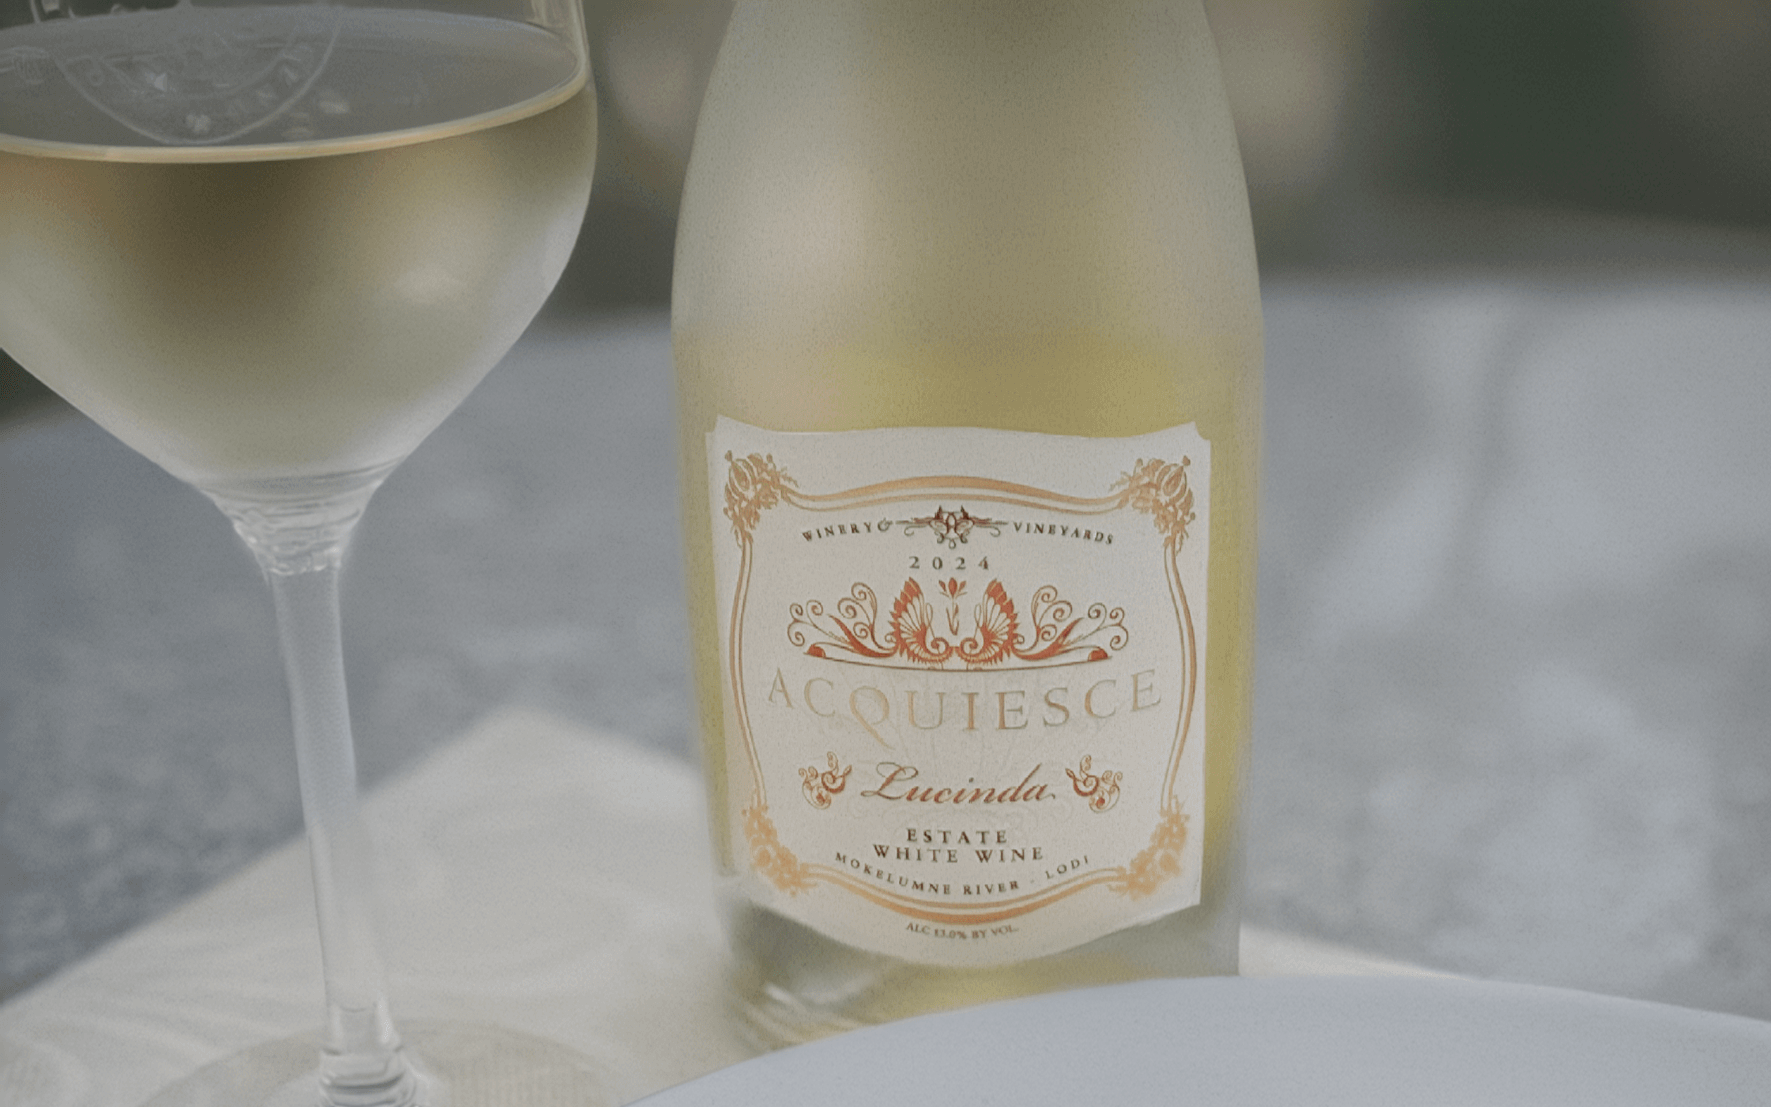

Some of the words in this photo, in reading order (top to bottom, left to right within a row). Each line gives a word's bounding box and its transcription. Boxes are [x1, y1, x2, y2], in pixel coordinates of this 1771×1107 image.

[802, 521, 872, 542] WINERY
[1013, 521, 1113, 545] VINEYARDS
[908, 555, 990, 571] 2024
[767, 667, 1163, 751] ACQUIESCE
[860, 761, 1055, 804] Lucinda
[906, 828, 1008, 844] ESTATE
[873, 844, 959, 864] WHITE
[974, 847, 1044, 864] WINE
[834, 852, 952, 896] MOKELUMNE
[962, 880, 1021, 896] RIVER
[1044, 855, 1091, 880] LODI
[971, 929, 987, 939] BY
